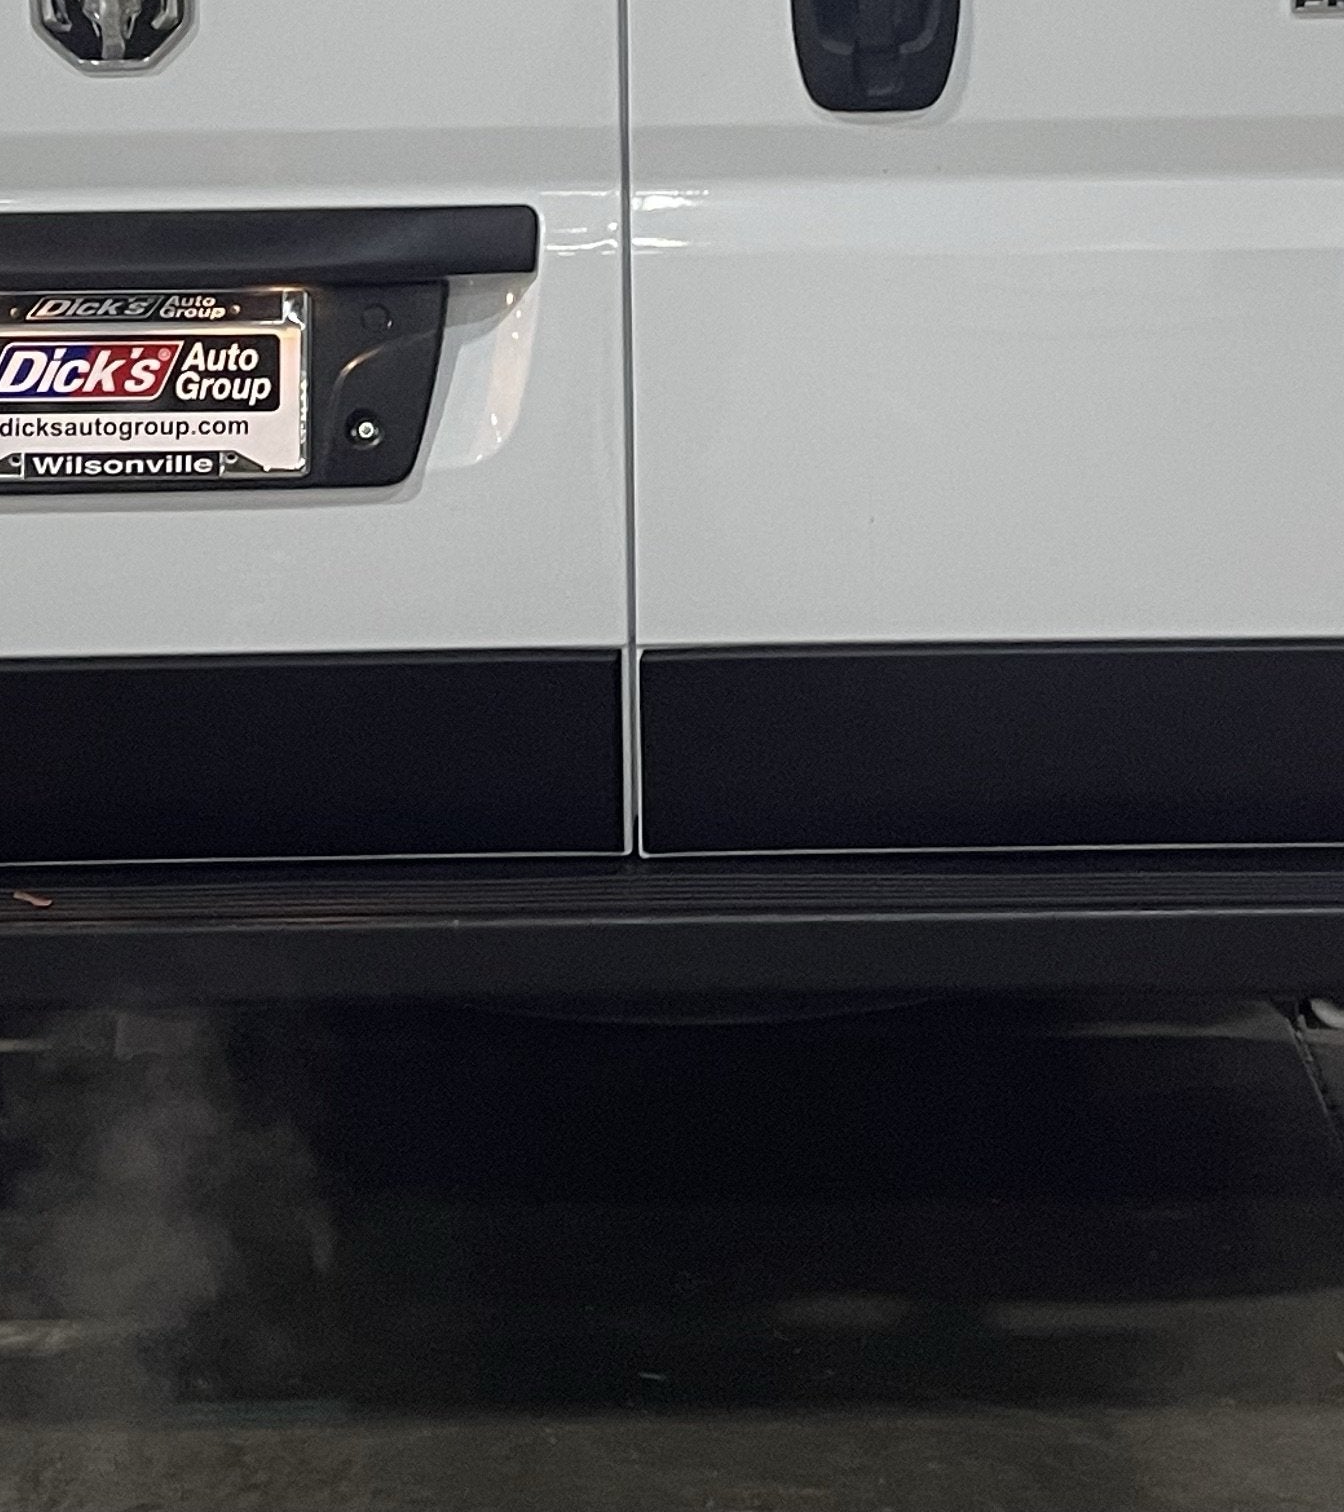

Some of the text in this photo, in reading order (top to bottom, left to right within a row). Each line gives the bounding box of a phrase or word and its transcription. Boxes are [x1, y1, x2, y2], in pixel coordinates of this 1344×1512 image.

[34, 295, 151, 317] Dick's
[169, 295, 217, 308] Auto
[159, 306, 227, 320] Group
[181, 341, 259, 372] Auto
[175, 371, 272, 406] Group
[32, 455, 214, 475] Wilsonville
